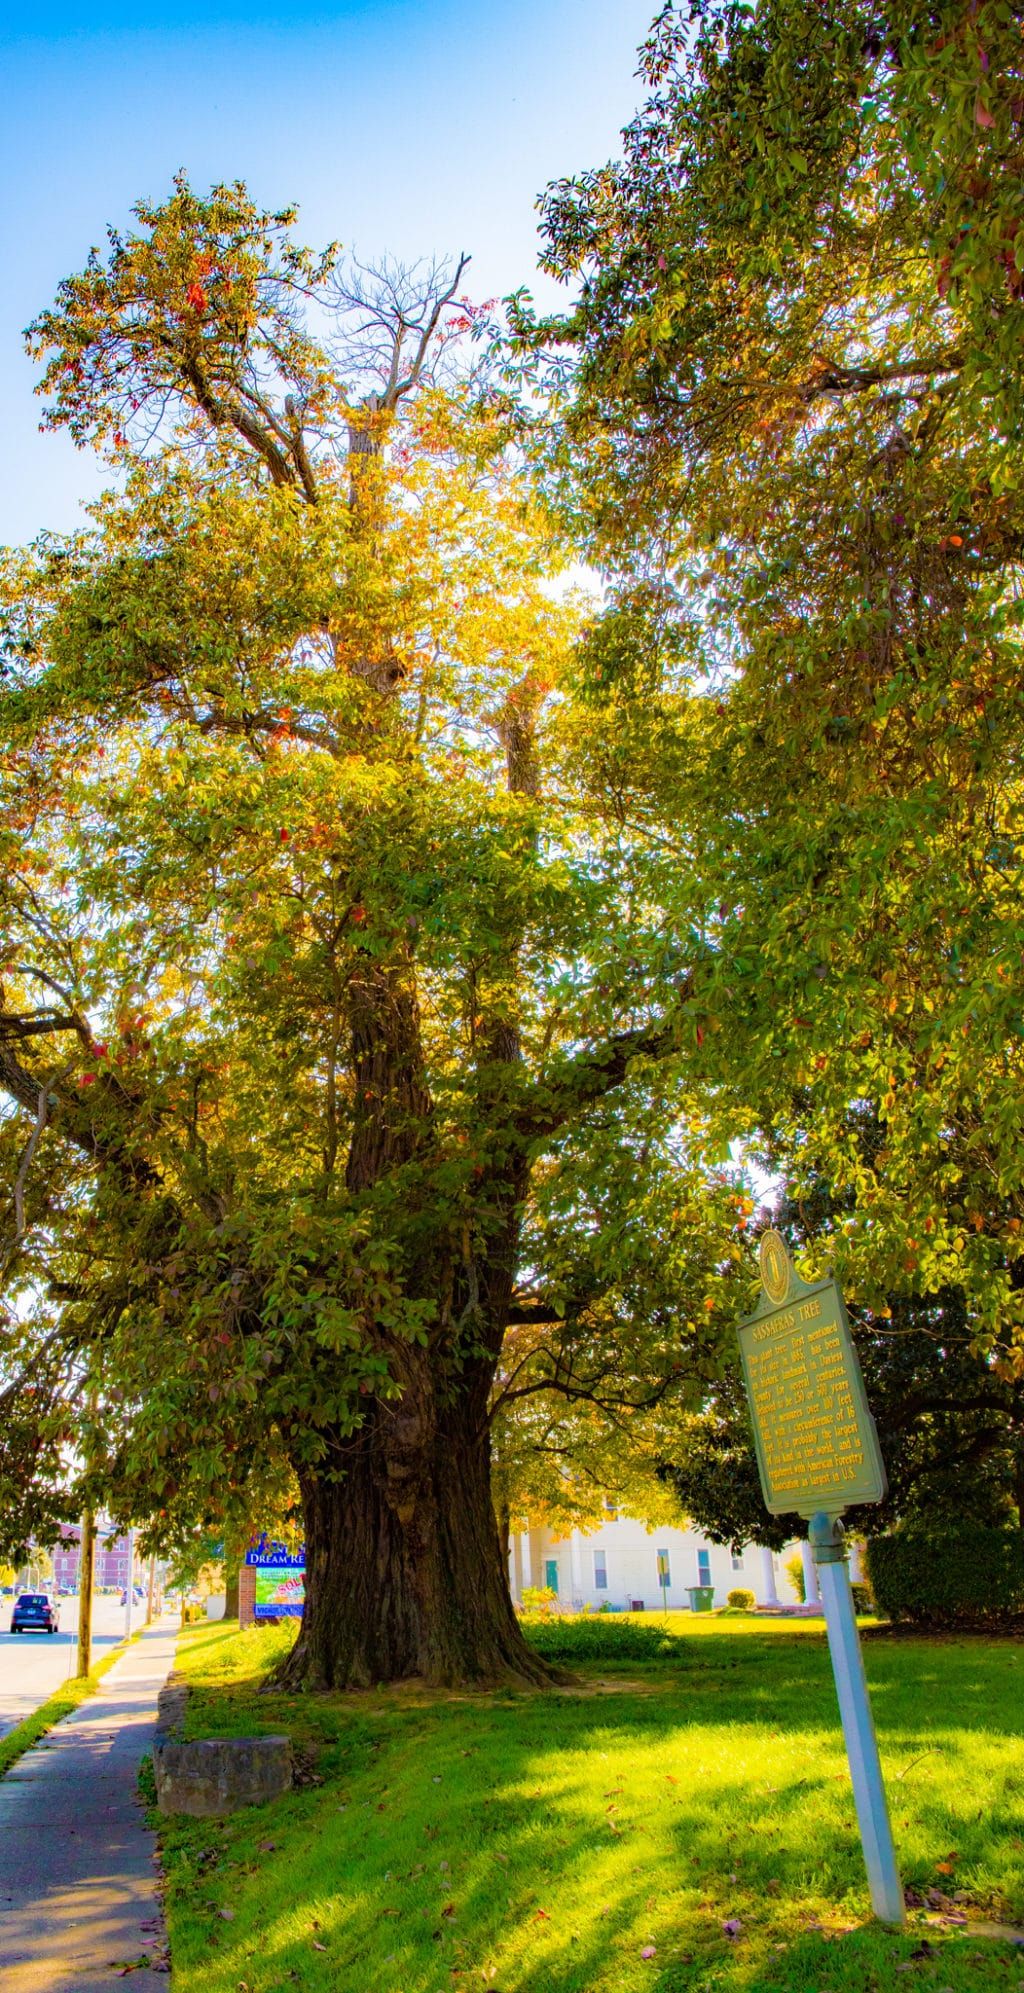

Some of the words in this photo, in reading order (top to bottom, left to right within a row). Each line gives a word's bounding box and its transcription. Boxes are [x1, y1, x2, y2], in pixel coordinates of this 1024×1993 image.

[752, 1313, 794, 1342] SASSAFRAS
[798, 1300, 820, 1321] TREE
[807, 1320, 837, 1342] mentioned
[811, 1345, 821, 1355] has
[824, 1338, 840, 1350] been
[782, 1364, 807, 1380] landmark
[790, 1376, 810, 1390] several
[831, 1380, 848, 1394] years
[779, 1410, 803, 1422] measures
[808, 1404, 819, 1413] over
[837, 1393, 852, 1406] feet
[794, 1415, 833, 1432] circumference
[836, 1408, 844, 1421] of
[792, 1432, 817, 1447] probably
[822, 1430, 832, 1440] the
[834, 1423, 858, 1437] largest
[804, 1448, 814, 1457] the
[839, 1438, 851, 1450] and
[807, 1459, 833, 1471] American
[834, 1453, 862, 1466] Forestry
[772, 1480, 800, 1491] Association
[810, 1473, 830, 1485] largest
[841, 1466, 856, 1480] U.S.
[250, 1554, 287, 1563] DREAM
